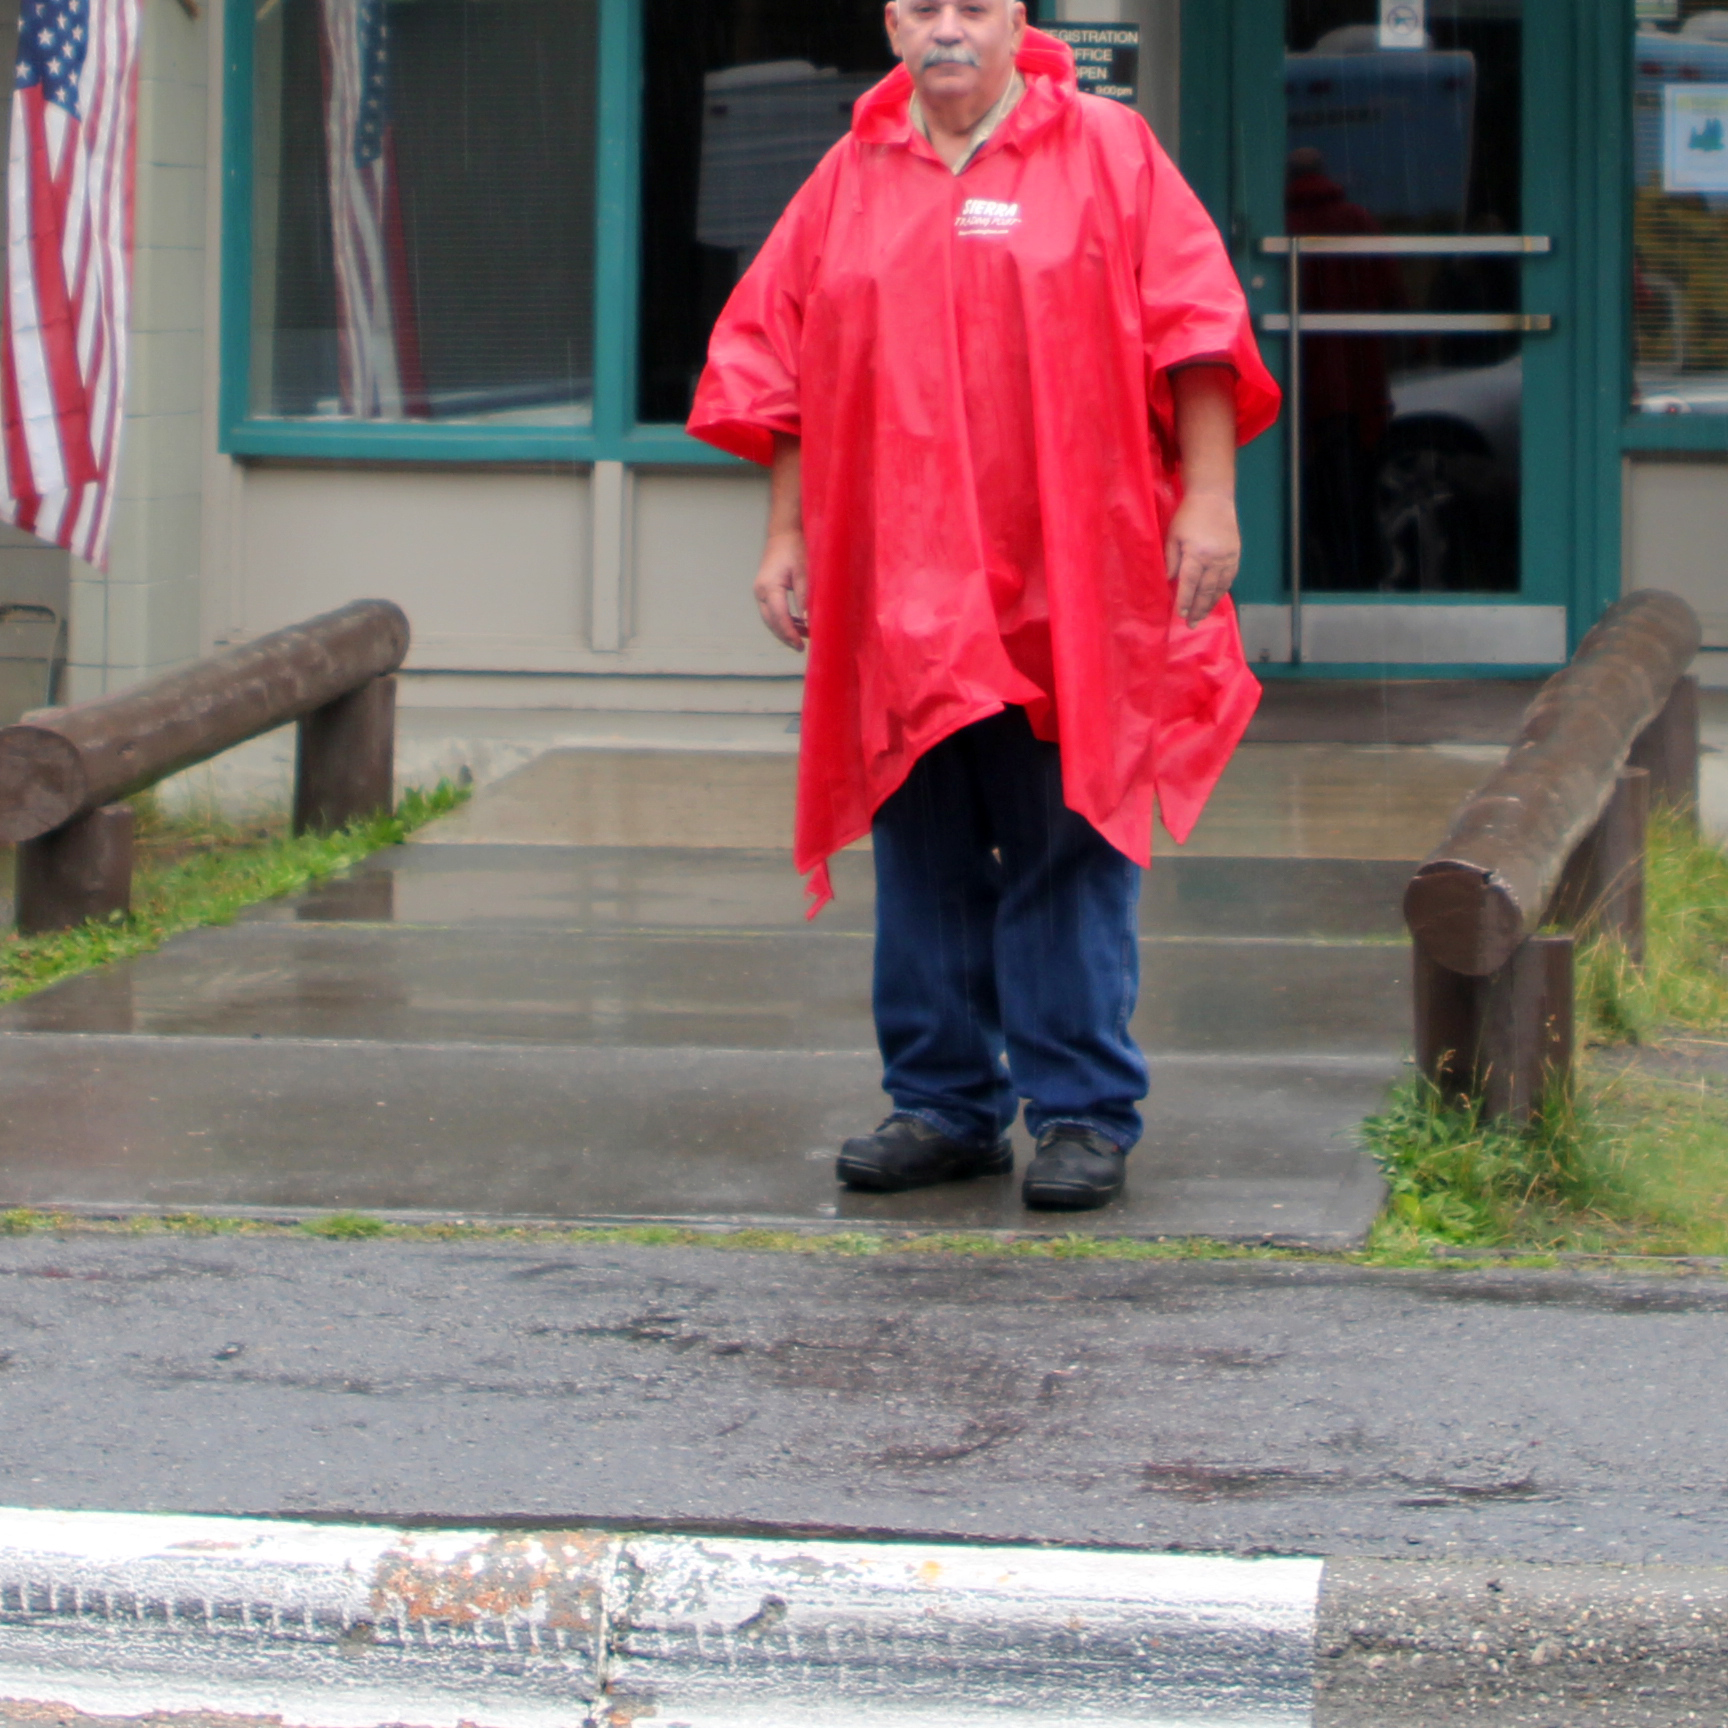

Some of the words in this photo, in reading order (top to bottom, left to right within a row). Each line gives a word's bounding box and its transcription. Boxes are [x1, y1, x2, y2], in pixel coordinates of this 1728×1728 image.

[1044, 29, 1139, 44] EGISTRATION
[1074, 47, 1113, 61] FFICE
[962, 199, 1018, 217] SIERRA
